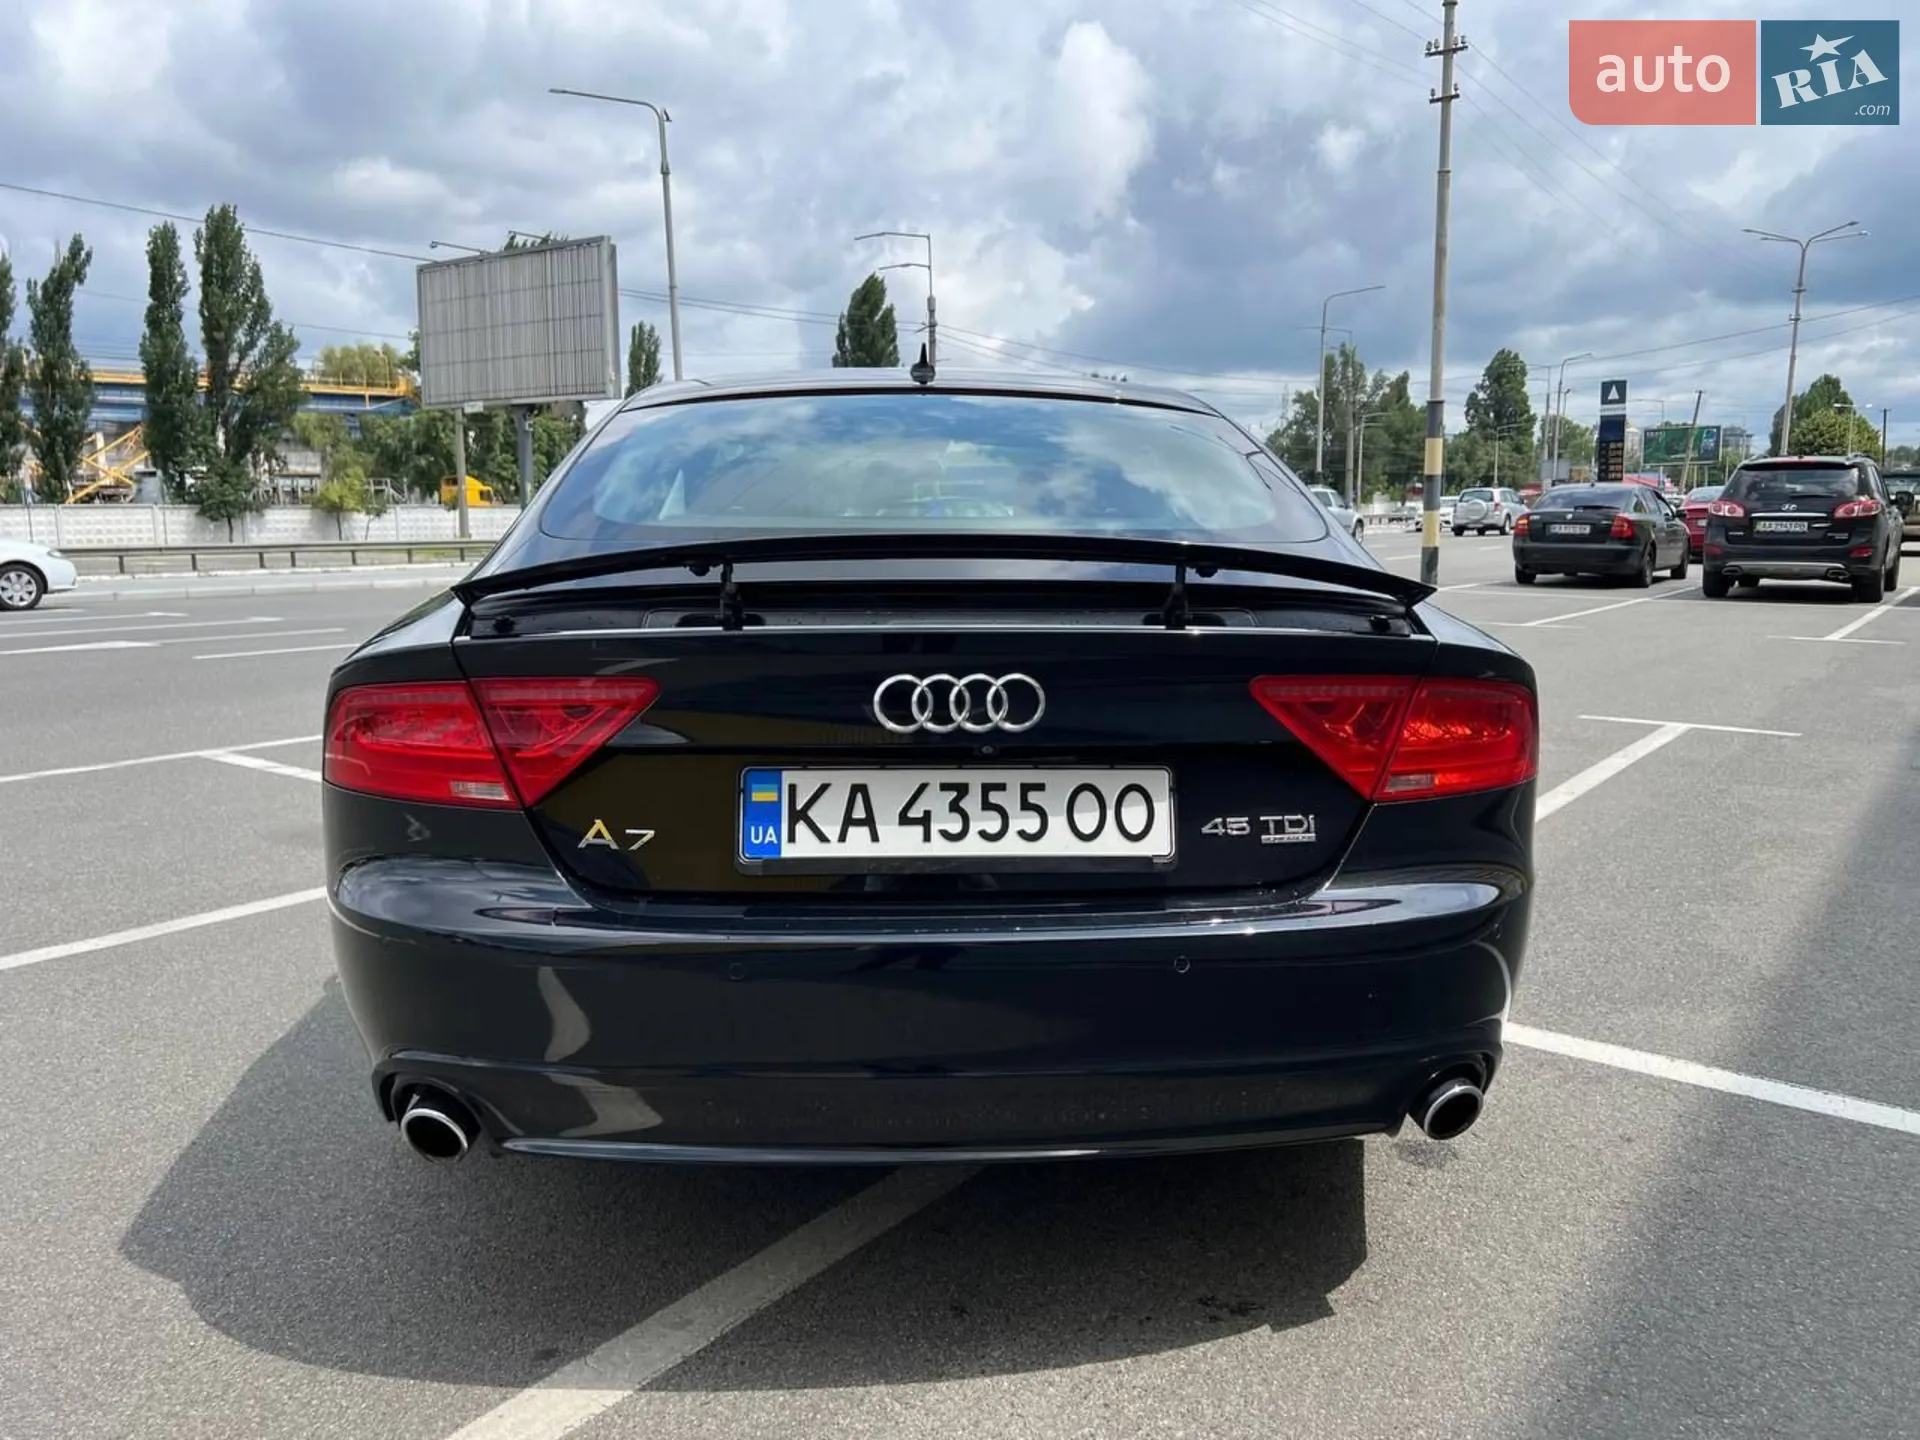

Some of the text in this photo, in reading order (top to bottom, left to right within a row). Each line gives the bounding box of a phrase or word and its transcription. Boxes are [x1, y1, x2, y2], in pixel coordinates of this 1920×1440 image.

[787, 781, 1155, 844] KA 4355 OO
[1200, 815, 1251, 837] 45
[577, 818, 656, 851] A7
[750, 825, 778, 845] UA
